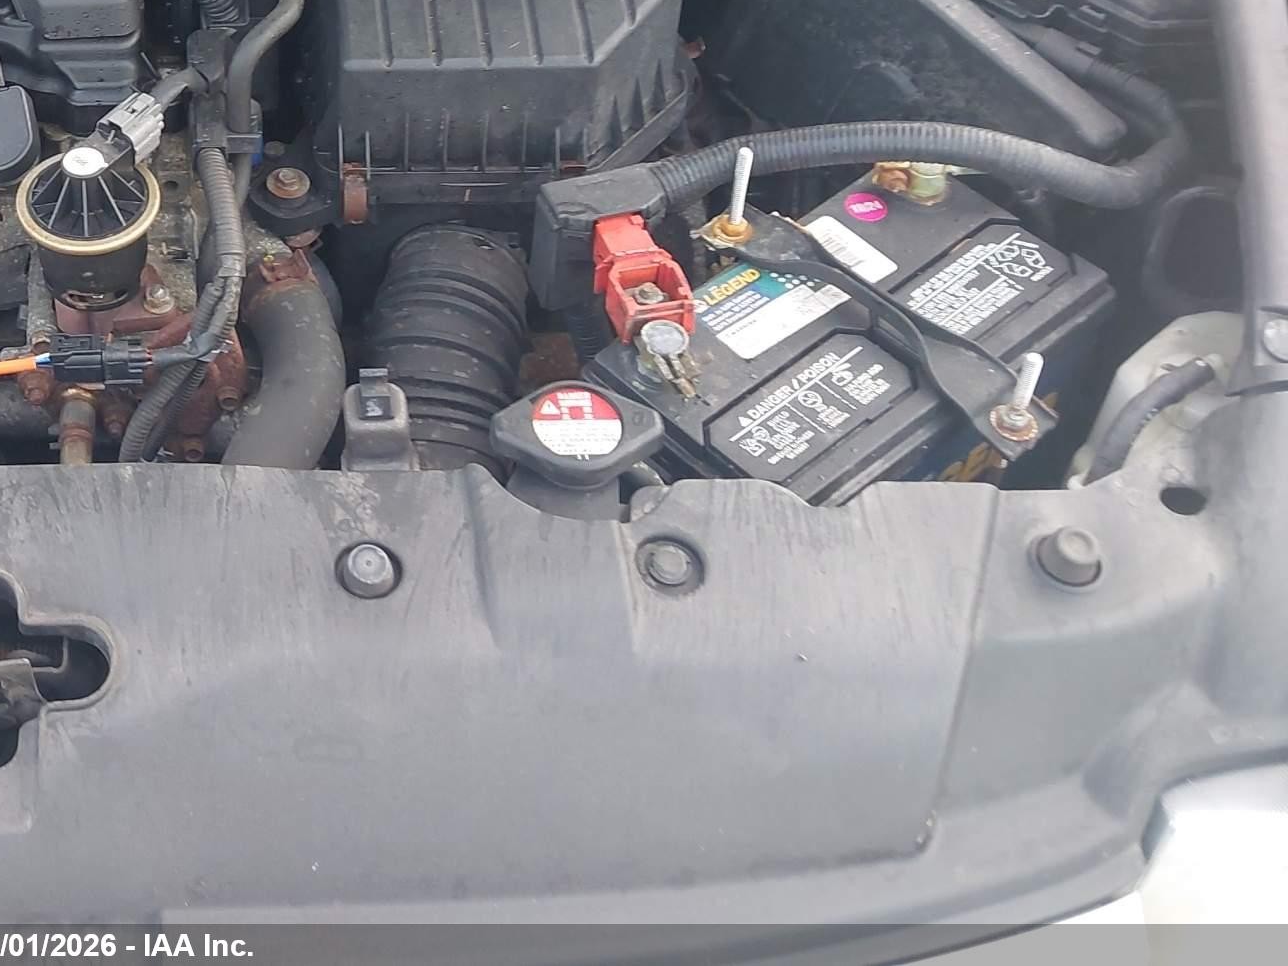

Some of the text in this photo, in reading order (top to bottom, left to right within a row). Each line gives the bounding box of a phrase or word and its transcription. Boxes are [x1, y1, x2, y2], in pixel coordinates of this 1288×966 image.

[702, 267, 761, 306] LEGEND
[746, 385, 795, 419] DANGER
[796, 352, 841, 383] POISON
